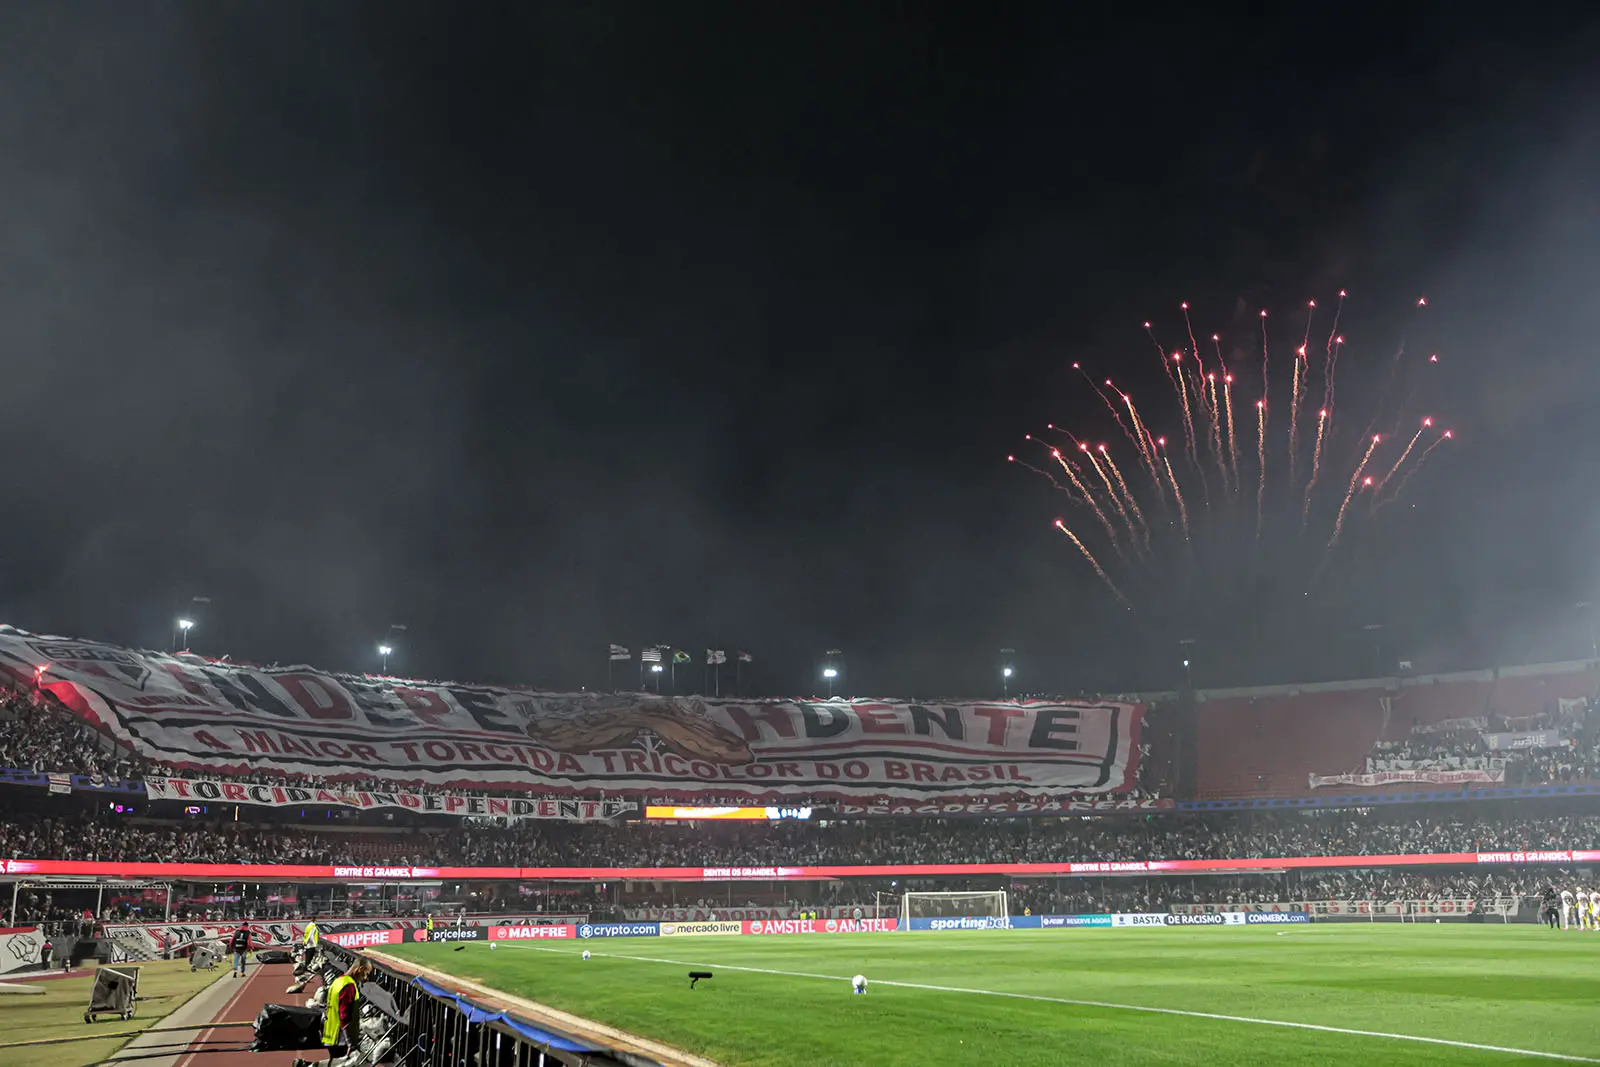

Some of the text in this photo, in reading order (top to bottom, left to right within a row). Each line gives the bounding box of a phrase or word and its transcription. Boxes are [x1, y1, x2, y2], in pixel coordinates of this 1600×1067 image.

[193, 728, 1032, 783] A MAIOR TORCIDA TRICOLOR DO BRASIL
[168, 778, 622, 819] TORCIDA INDEPENDENTE
[1017, 801, 1062, 812] DA
[1066, 798, 1161, 812] REAL
[1477, 852, 1511, 863] DENTRE
[1513, 852, 1525, 862] OS
[1526, 851, 1570, 862] GRANDES,
[334, 867, 362, 877] DENTRE
[364, 867, 374, 877] OS
[374, 867, 411, 878] GRANDES,
[703, 867, 731, 877] DENTRE
[732, 867, 741, 876] OS
[742, 867, 776, 877] GRANDES,
[1071, 862, 1099, 872] DENTRE
[1100, 862, 1110, 871] OS
[1111, 861, 1147, 872] GRANDES,
[693, 910, 706, 920] A
[715, 909, 780, 920] MOEDA
[1133, 914, 1222, 925] BASTA DE RACISMO
[1248, 912, 1306, 923] CONMEBOL.com
[594, 924, 656, 937] crypto.com
[677, 923, 740, 933] mercado livre
[765, 920, 816, 933] AMSTEL
[839, 918, 885, 932] AMSTEL
[433, 928, 477, 940] priceless
[509, 926, 567, 938] MAPFRE
[339, 931, 389, 948] MAPFRE
